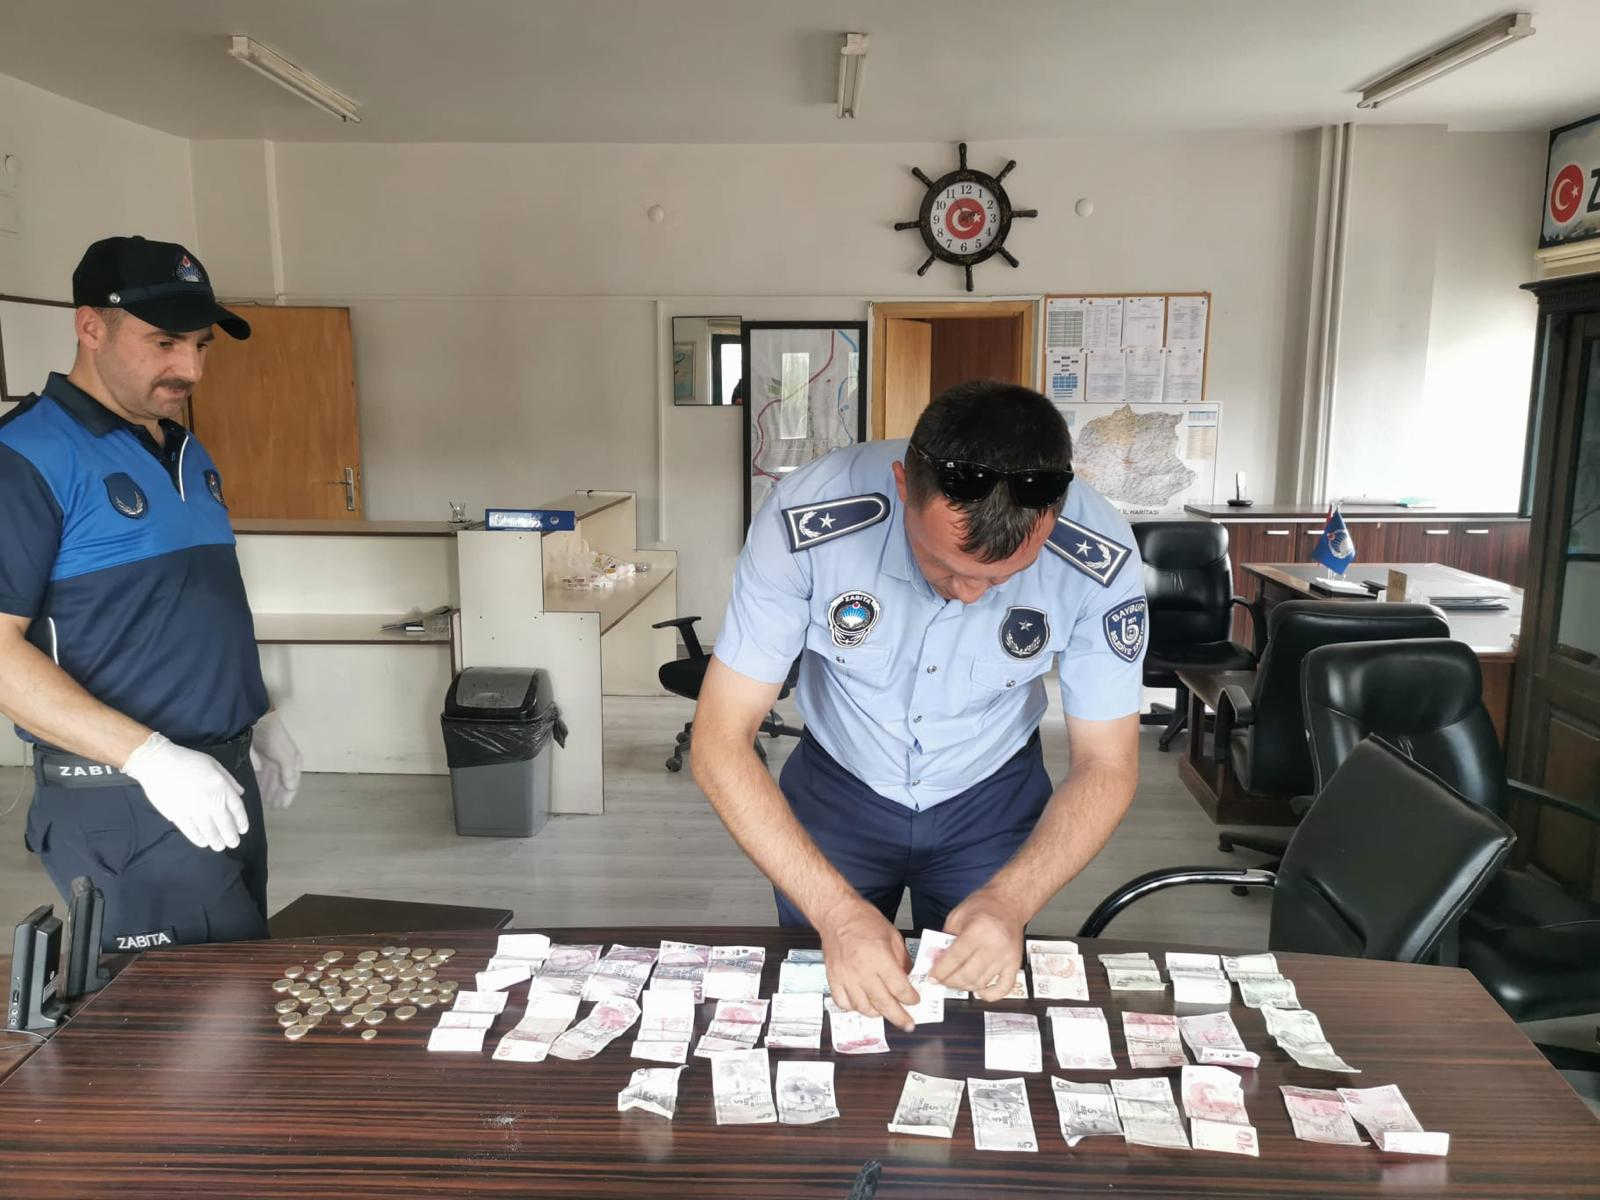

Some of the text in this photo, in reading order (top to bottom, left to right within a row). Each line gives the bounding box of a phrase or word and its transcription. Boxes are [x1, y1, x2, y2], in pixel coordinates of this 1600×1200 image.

[946, 188, 956, 199] 11
[960, 184, 973, 195] 12
[978, 188, 983, 199] 1
[936, 200, 946, 210] 10
[987, 200, 994, 209] 2
[932, 215, 940, 224] 9
[990, 214, 997, 223] 3
[937, 228, 944, 238] 8
[985, 227, 992, 237] 4
[946, 239, 953, 248] 7
[960, 242, 968, 252] 6
[975, 239, 982, 248] 5
[116, 932, 171, 950] ZABITA
[1235, 1130, 1255, 1151] 10
